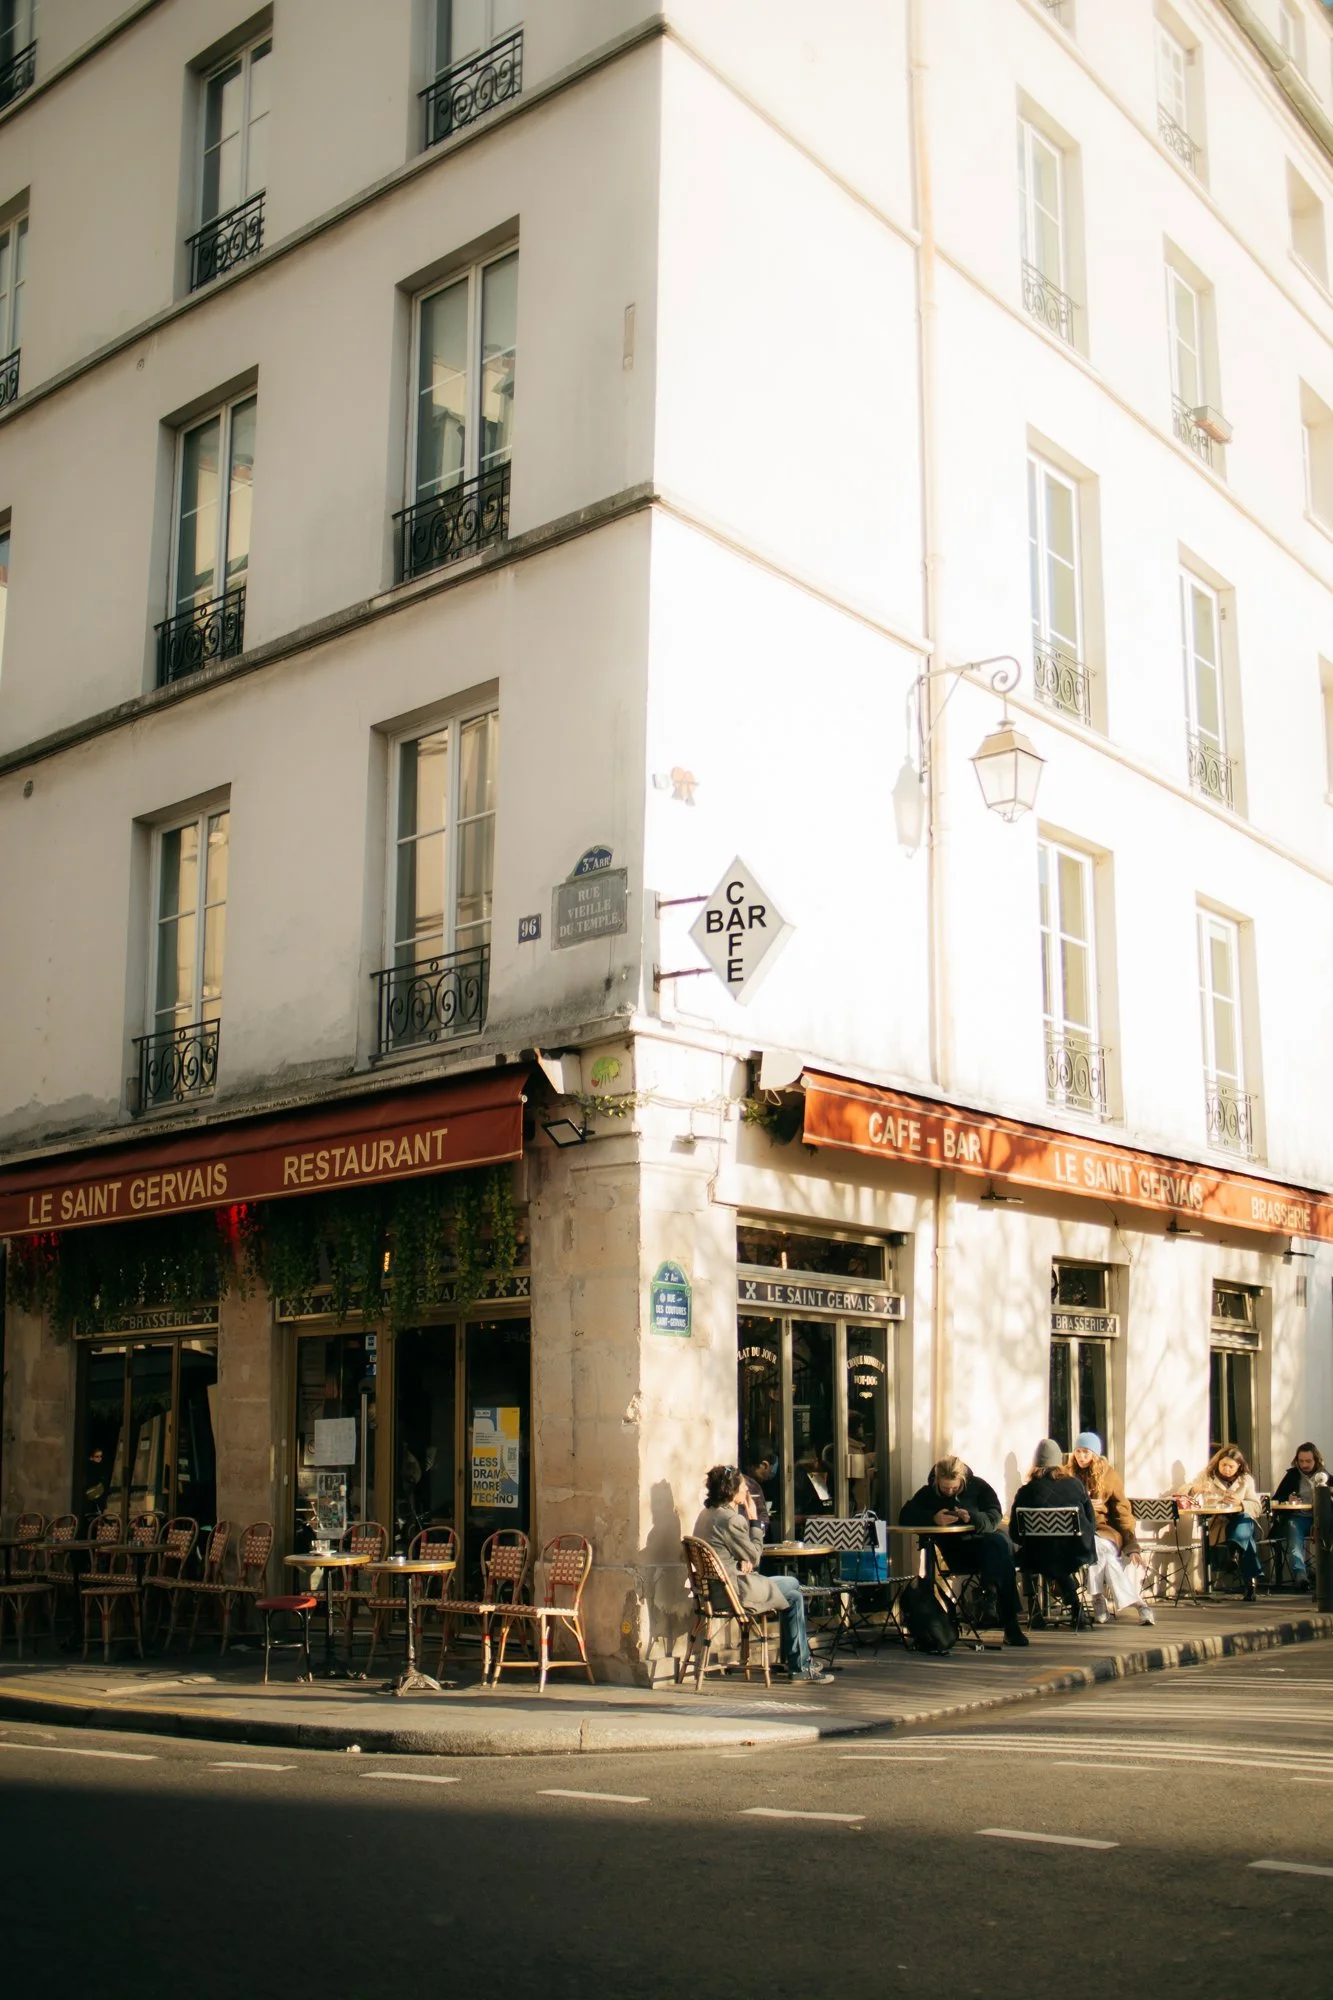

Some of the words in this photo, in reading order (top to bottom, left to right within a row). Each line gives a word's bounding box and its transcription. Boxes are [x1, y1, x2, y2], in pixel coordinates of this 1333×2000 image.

[578, 886, 600, 902] RUE
[568, 899, 611, 919] VIEILLE
[521, 919, 537, 937] 96
[706, 905, 767, 935] BAR
[560, 925, 573, 938] DU
[726, 881, 746, 983] CAFE
[868, 1111, 921, 1151] CAFE
[943, 1128, 982, 1164] BAR
[283, 1128, 449, 1185] RESTAURANT
[1053, 1152, 1079, 1184] LE
[1083, 1156, 1132, 1194] SAINT
[1138, 1169, 1204, 1210] GERVAIS
[28, 1193, 52, 1225] LE
[60, 1181, 122, 1222] SAINT
[129, 1162, 229, 1210] GERVAIS
[1250, 1196, 1311, 1231] BRASSERIE
[766, 1284, 784, 1302] LE
[787, 1287, 824, 1307] SAINT
[827, 1291, 876, 1312] GERVAIS
[655, 1304, 664, 1314] DES
[128, 1311, 193, 1330] BRASSERIE
[1055, 1315, 1105, 1332] BRASSERIE
[751, 1346, 760, 1357] DU
[761, 1348, 777, 1364] JOUR
[854, 1375, 878, 1386] HOT-DOG
[473, 1457, 498, 1467] LESS
[473, 1481, 500, 1491] MORE
[473, 1493, 514, 1504] TECHNO
